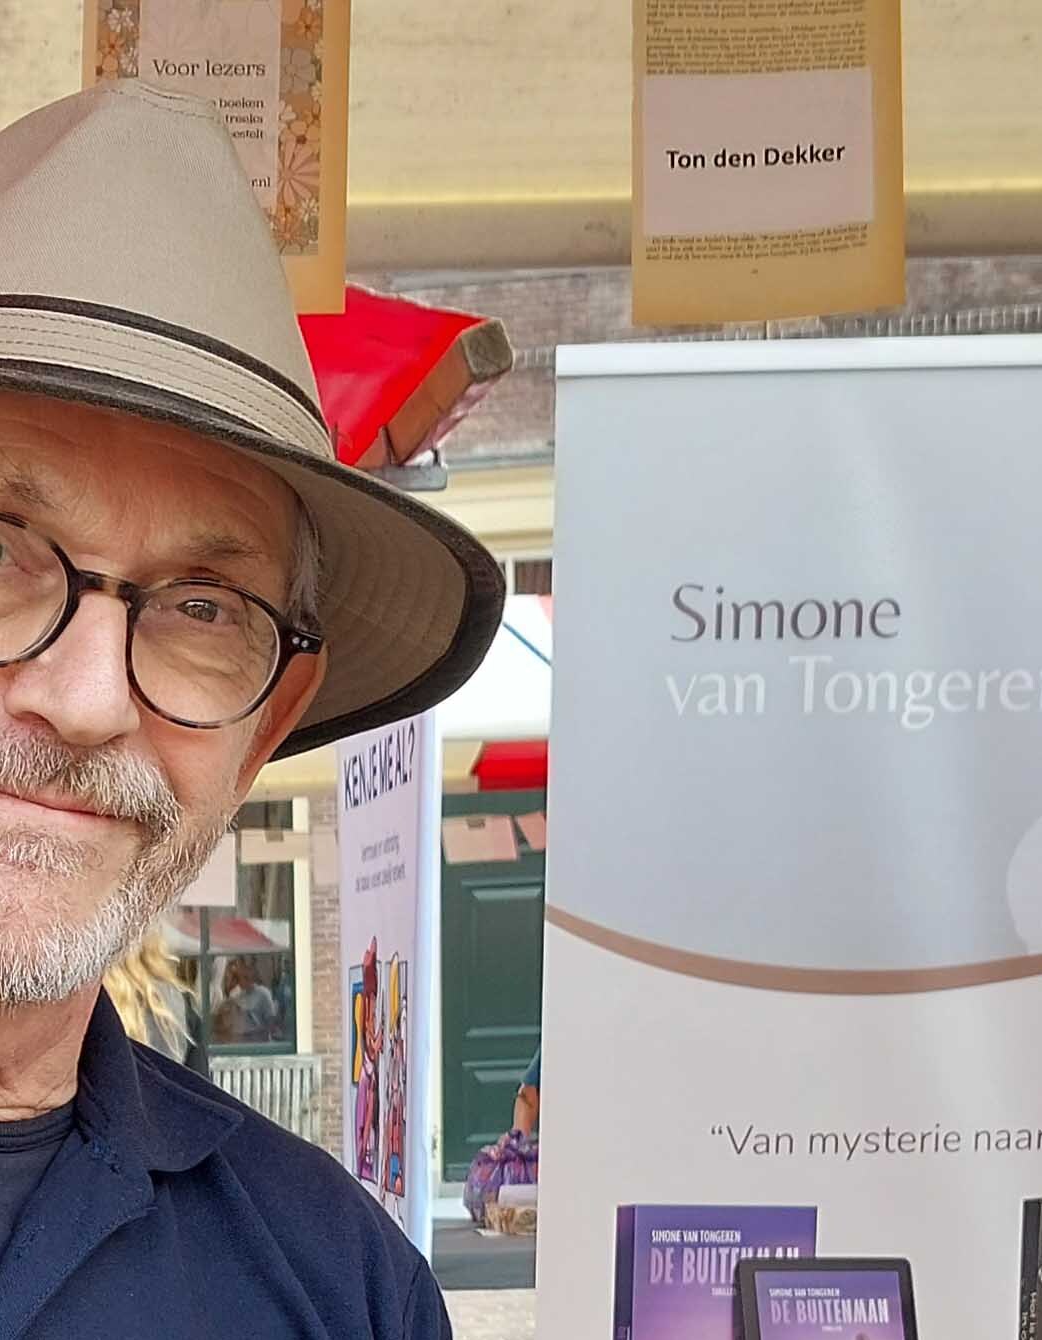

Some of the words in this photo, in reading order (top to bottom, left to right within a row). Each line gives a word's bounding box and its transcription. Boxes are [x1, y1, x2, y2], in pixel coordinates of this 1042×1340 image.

[152, 59, 200, 77] Voor
[206, 59, 266, 77] lezers
[666, 149, 706, 170] Ton
[713, 147, 756, 168] den
[763, 142, 846, 167] Dekker
[670, 584, 901, 642] Simone
[665, 672, 766, 716] van
[788, 655, 1042, 730] Tongere
[808, 1122, 962, 1162] mysterie
[682, 1229, 699, 1243] VAN
[650, 1248, 674, 1285] DE
[770, 1301, 792, 1324] DE
[796, 1297, 889, 1324] BUITENMAN
